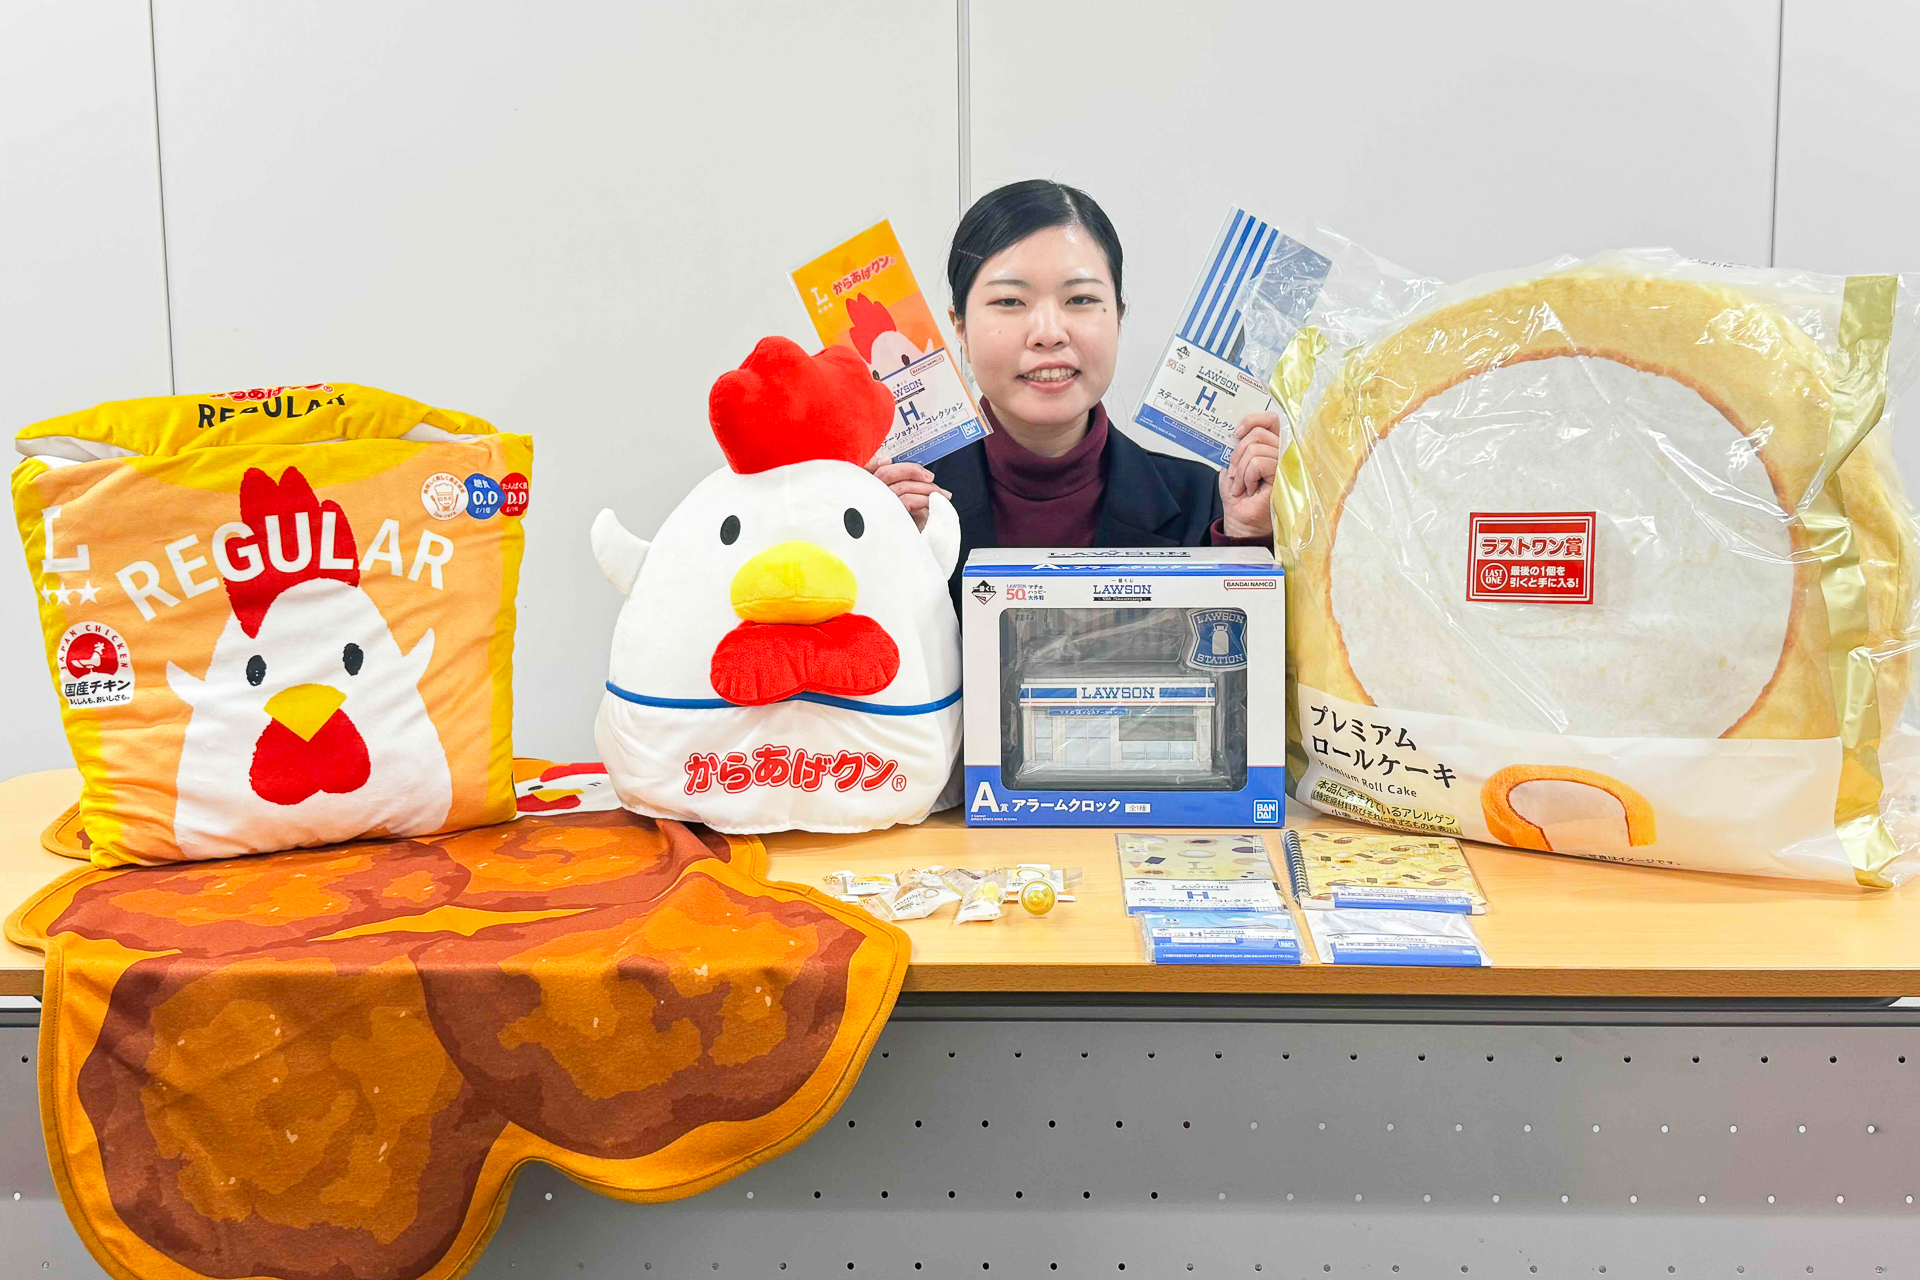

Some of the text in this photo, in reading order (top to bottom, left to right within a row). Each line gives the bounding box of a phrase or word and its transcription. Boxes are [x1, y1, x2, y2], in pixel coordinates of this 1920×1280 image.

[1198, 366, 1240, 392] LAWSON
[1481, 537, 1583, 557] ラストワン賞
[115, 511, 455, 622] REGULAR
[1485, 569, 1503, 577] LAST
[1510, 566, 1566, 577] 最後の1個を
[1485, 576, 1502, 585] ONE
[1093, 585, 1152, 595] LAWSON
[1197, 612, 1245, 624] LAWSON
[59, 624, 128, 670] JAPAN CHICKEN
[1196, 653, 1245, 665] STATION
[65, 679, 131, 697] 国産チキン
[1081, 687, 1155, 699] LAWSON
[1310, 705, 1417, 751] プレミアム
[1312, 735, 1457, 788] ロールケーキ
[1361, 778, 1383, 793] Roll
[1387, 784, 1417, 798] Cake
[1012, 798, 1121, 813] アラームクロック
[1256, 803, 1276, 811] BAN
[1256, 811, 1272, 819] DAI
